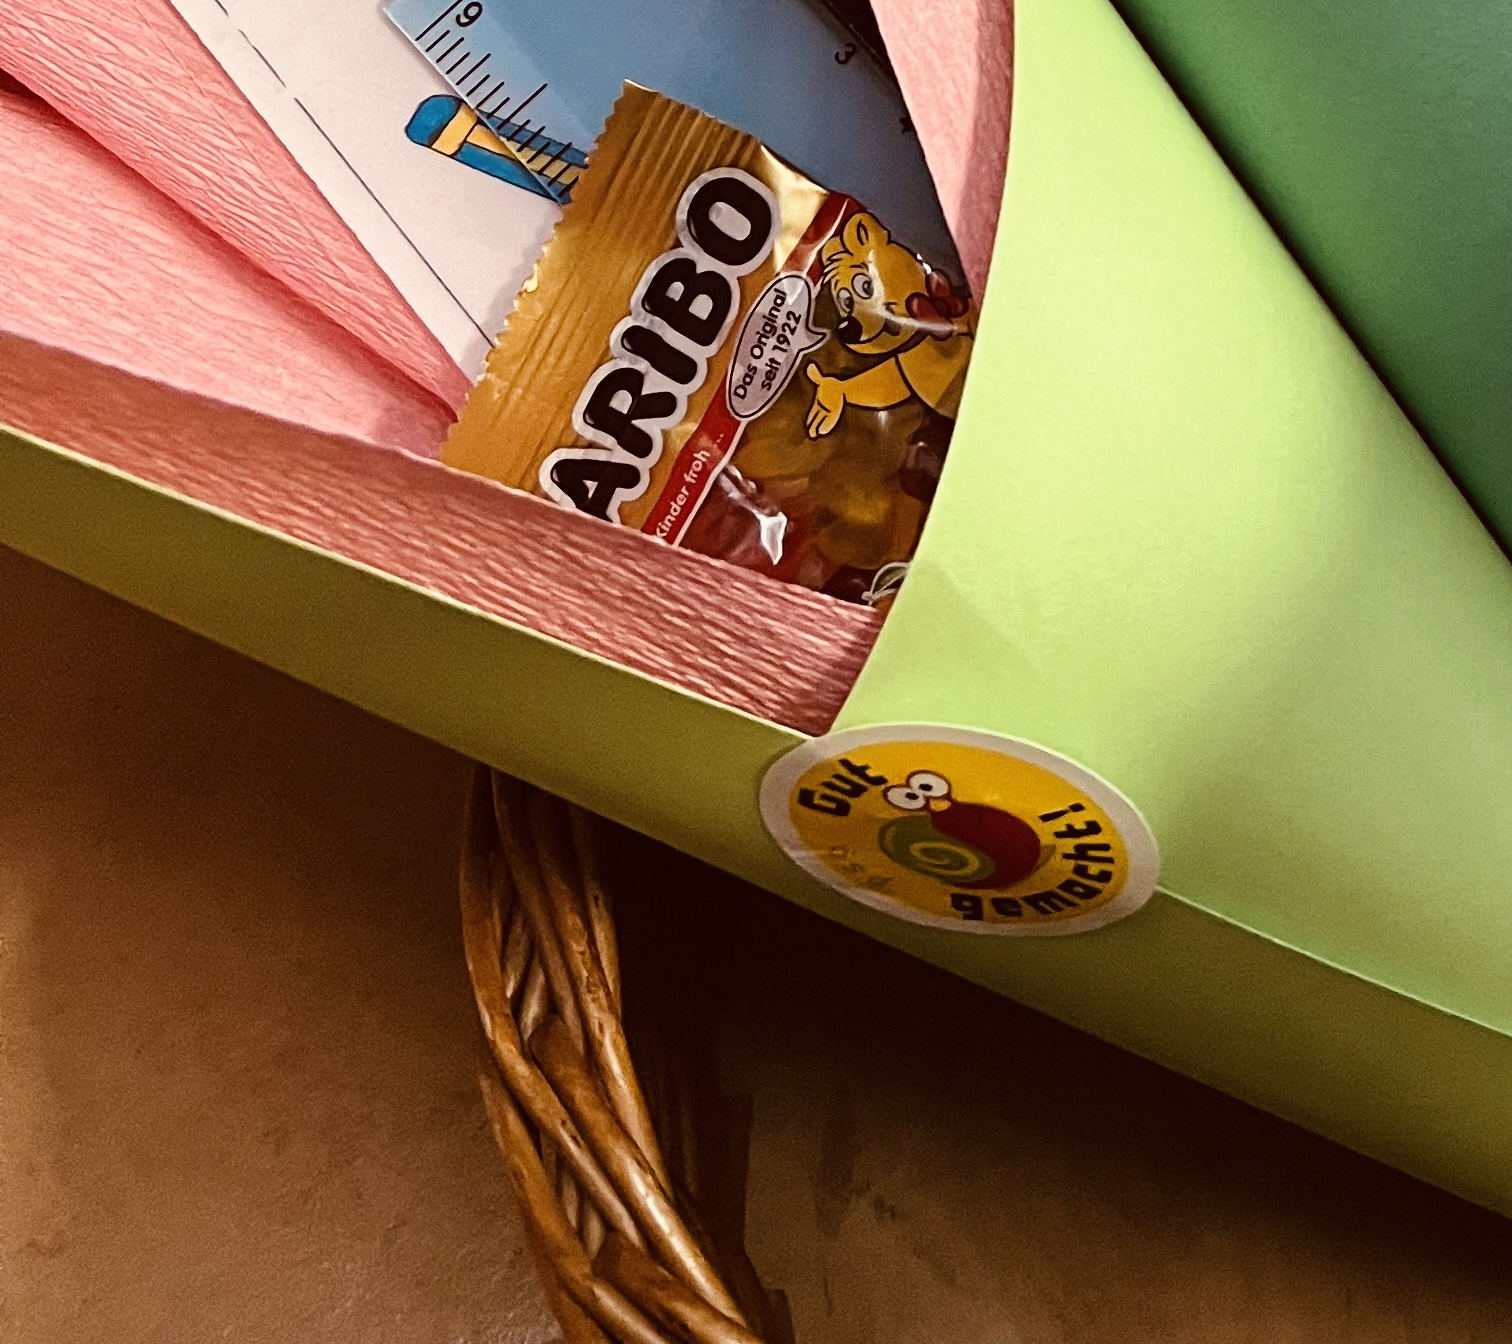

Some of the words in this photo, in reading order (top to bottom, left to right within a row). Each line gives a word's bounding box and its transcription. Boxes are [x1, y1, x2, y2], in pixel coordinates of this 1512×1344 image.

[550, 177, 773, 524] ARIBO
[733, 363, 758, 401] Das
[749, 287, 788, 360] Original
[761, 357, 782, 392] seit
[772, 310, 802, 353] 1922
[797, 758, 889, 817] Gut
[949, 802, 1116, 922] gemacht!
